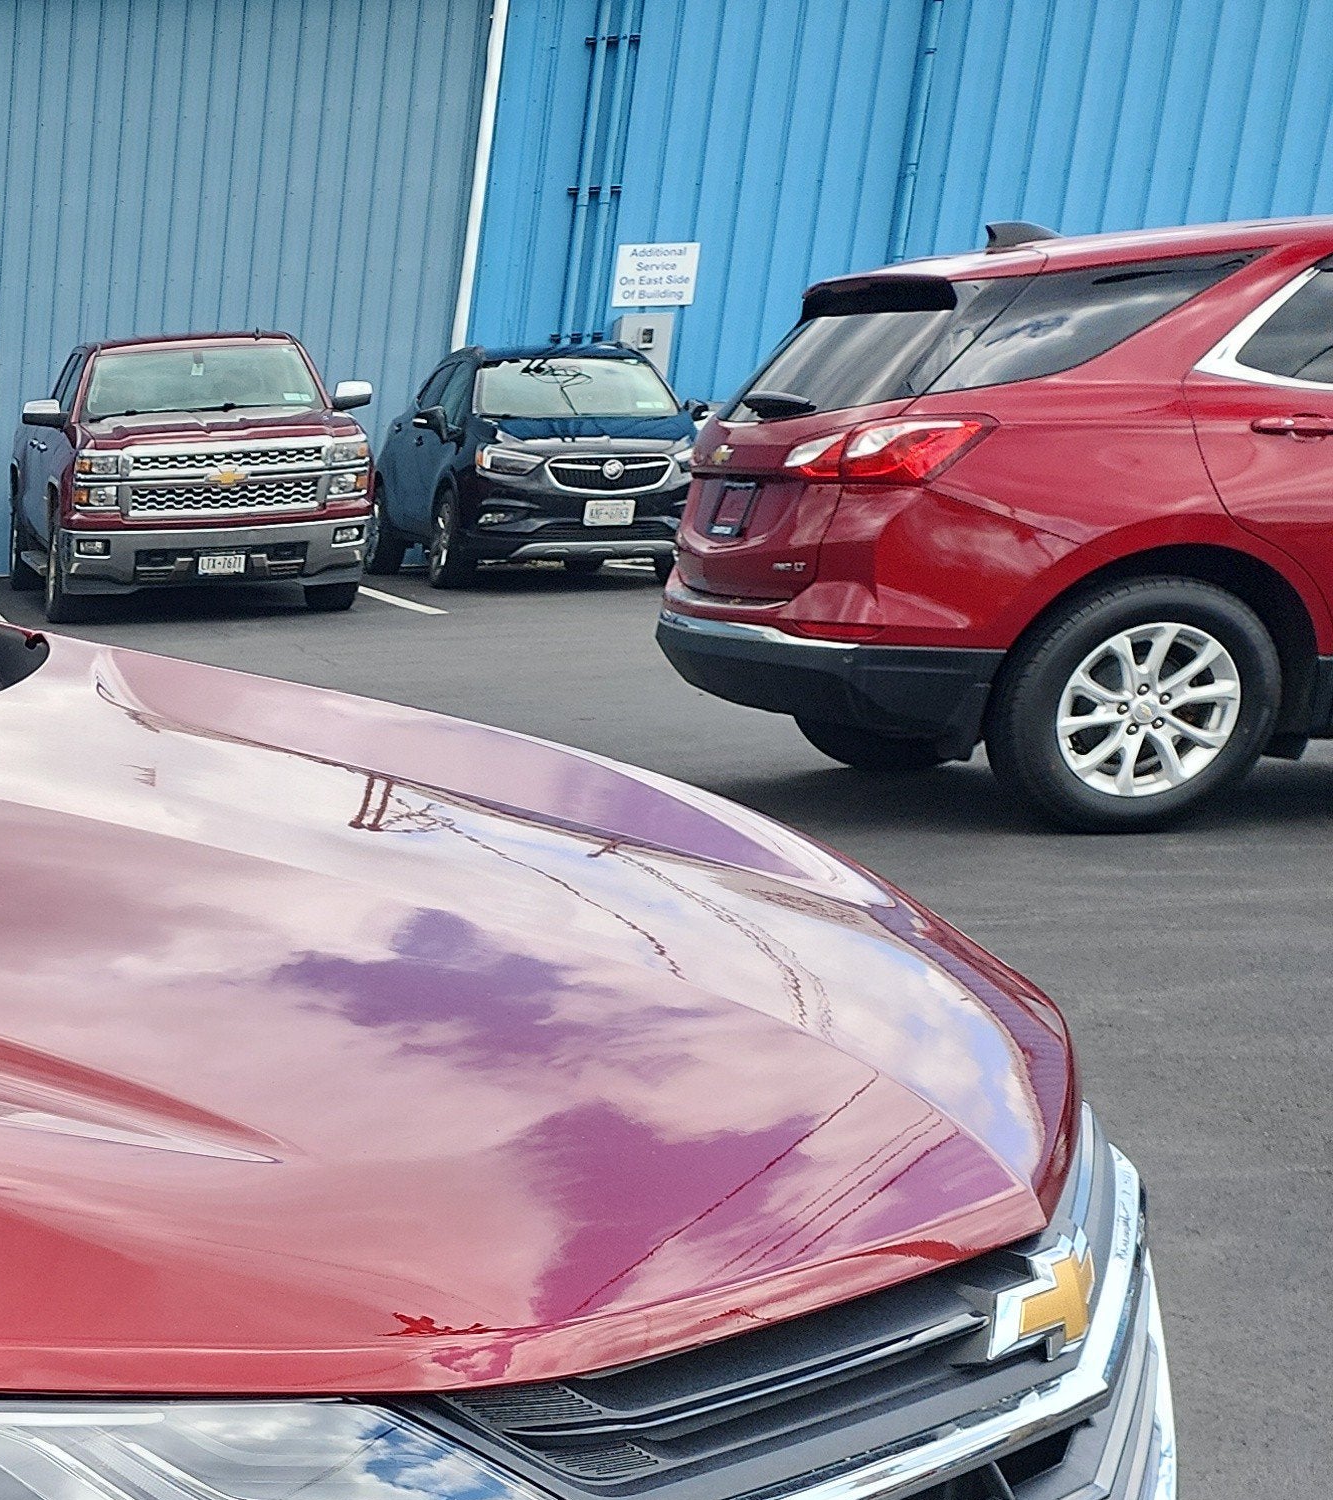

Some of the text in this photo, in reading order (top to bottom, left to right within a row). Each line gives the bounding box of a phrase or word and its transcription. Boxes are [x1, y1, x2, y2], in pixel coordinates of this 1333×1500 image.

[630, 247, 687, 258] Additional
[636, 262, 677, 271] Service
[619, 275, 690, 286] On East Side
[622, 289, 684, 300] Of Building
